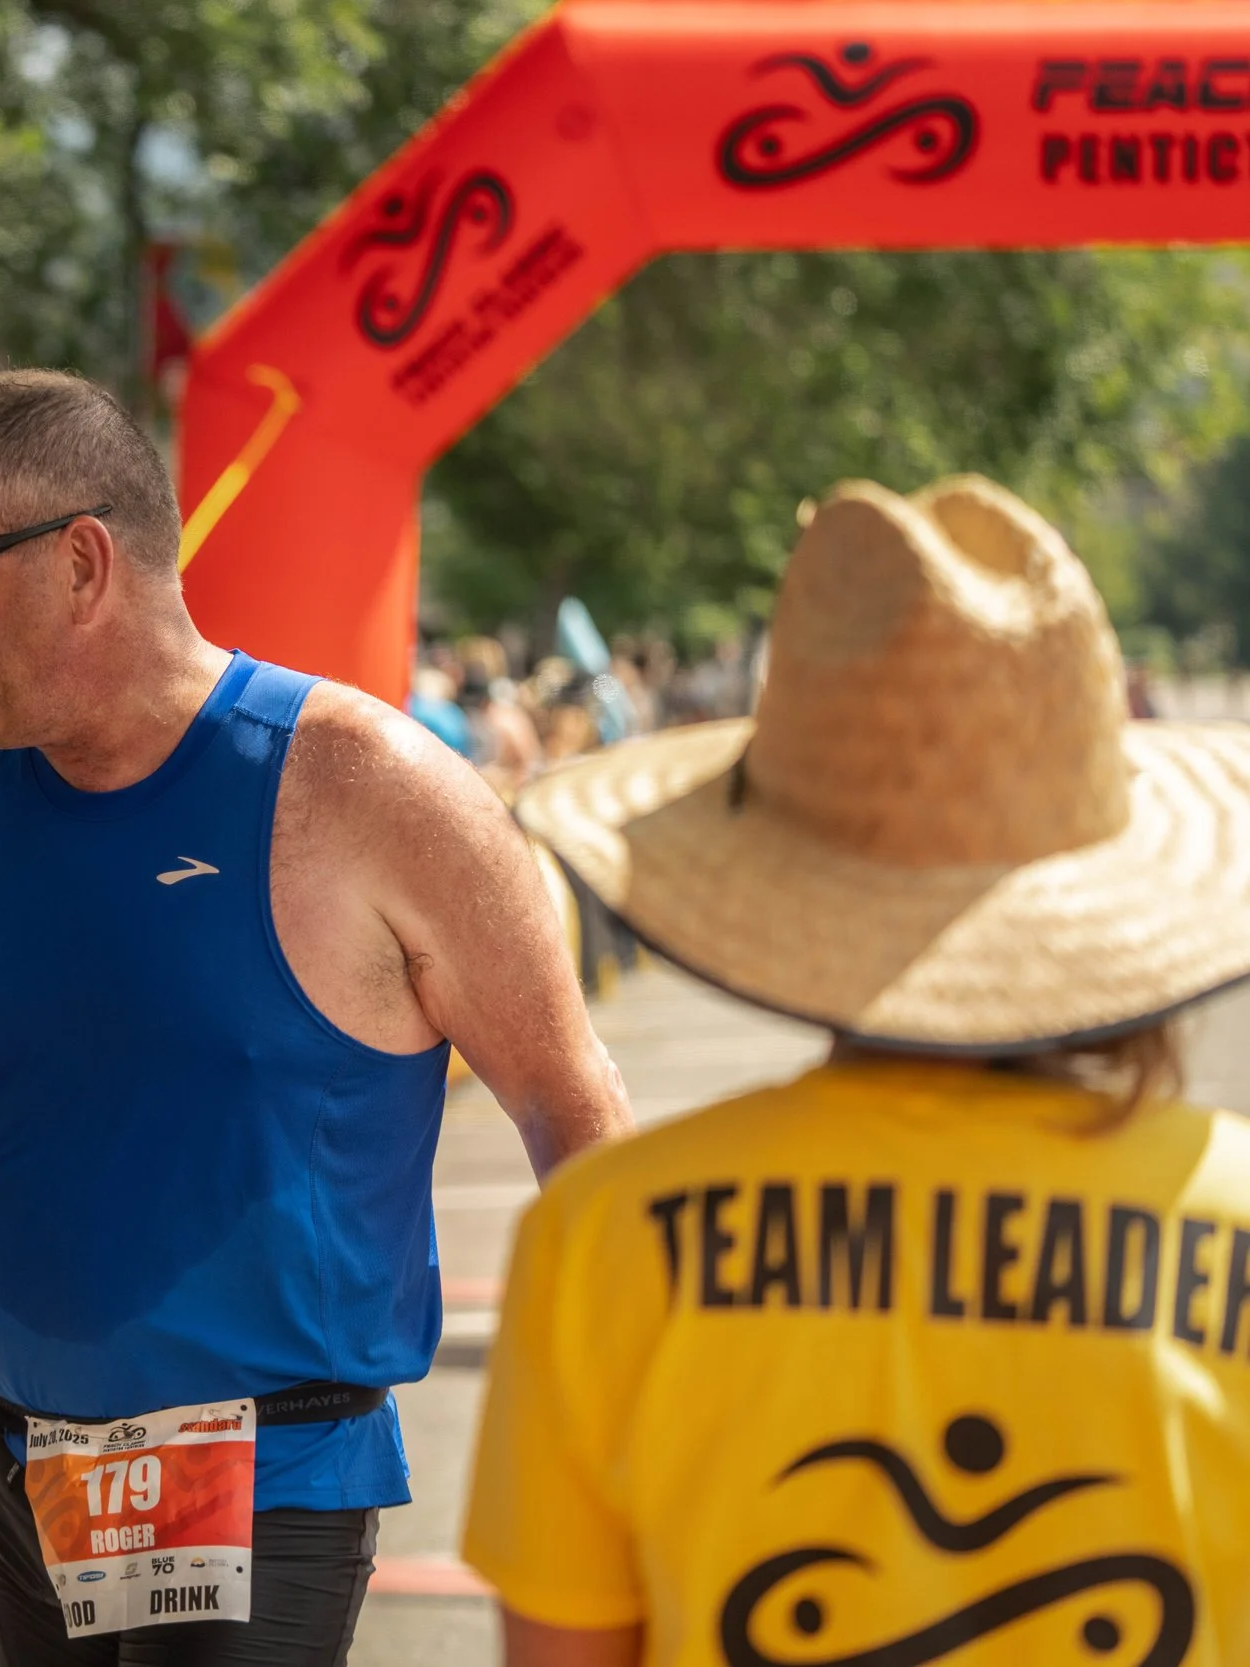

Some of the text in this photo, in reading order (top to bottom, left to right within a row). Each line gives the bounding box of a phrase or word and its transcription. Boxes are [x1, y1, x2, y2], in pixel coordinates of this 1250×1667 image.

[1042, 132, 1250, 183] PENTIC
[647, 1181, 895, 1313] TEAM
[30, 1433, 48, 1448] July
[59, 1428, 89, 1445] 2025
[81, 1455, 162, 1516] 179
[90, 1523, 155, 1554] ROGER
[151, 1556, 175, 1565] BLUE
[152, 1563, 174, 1576] 70
[150, 1585, 219, 1615] DRINK
